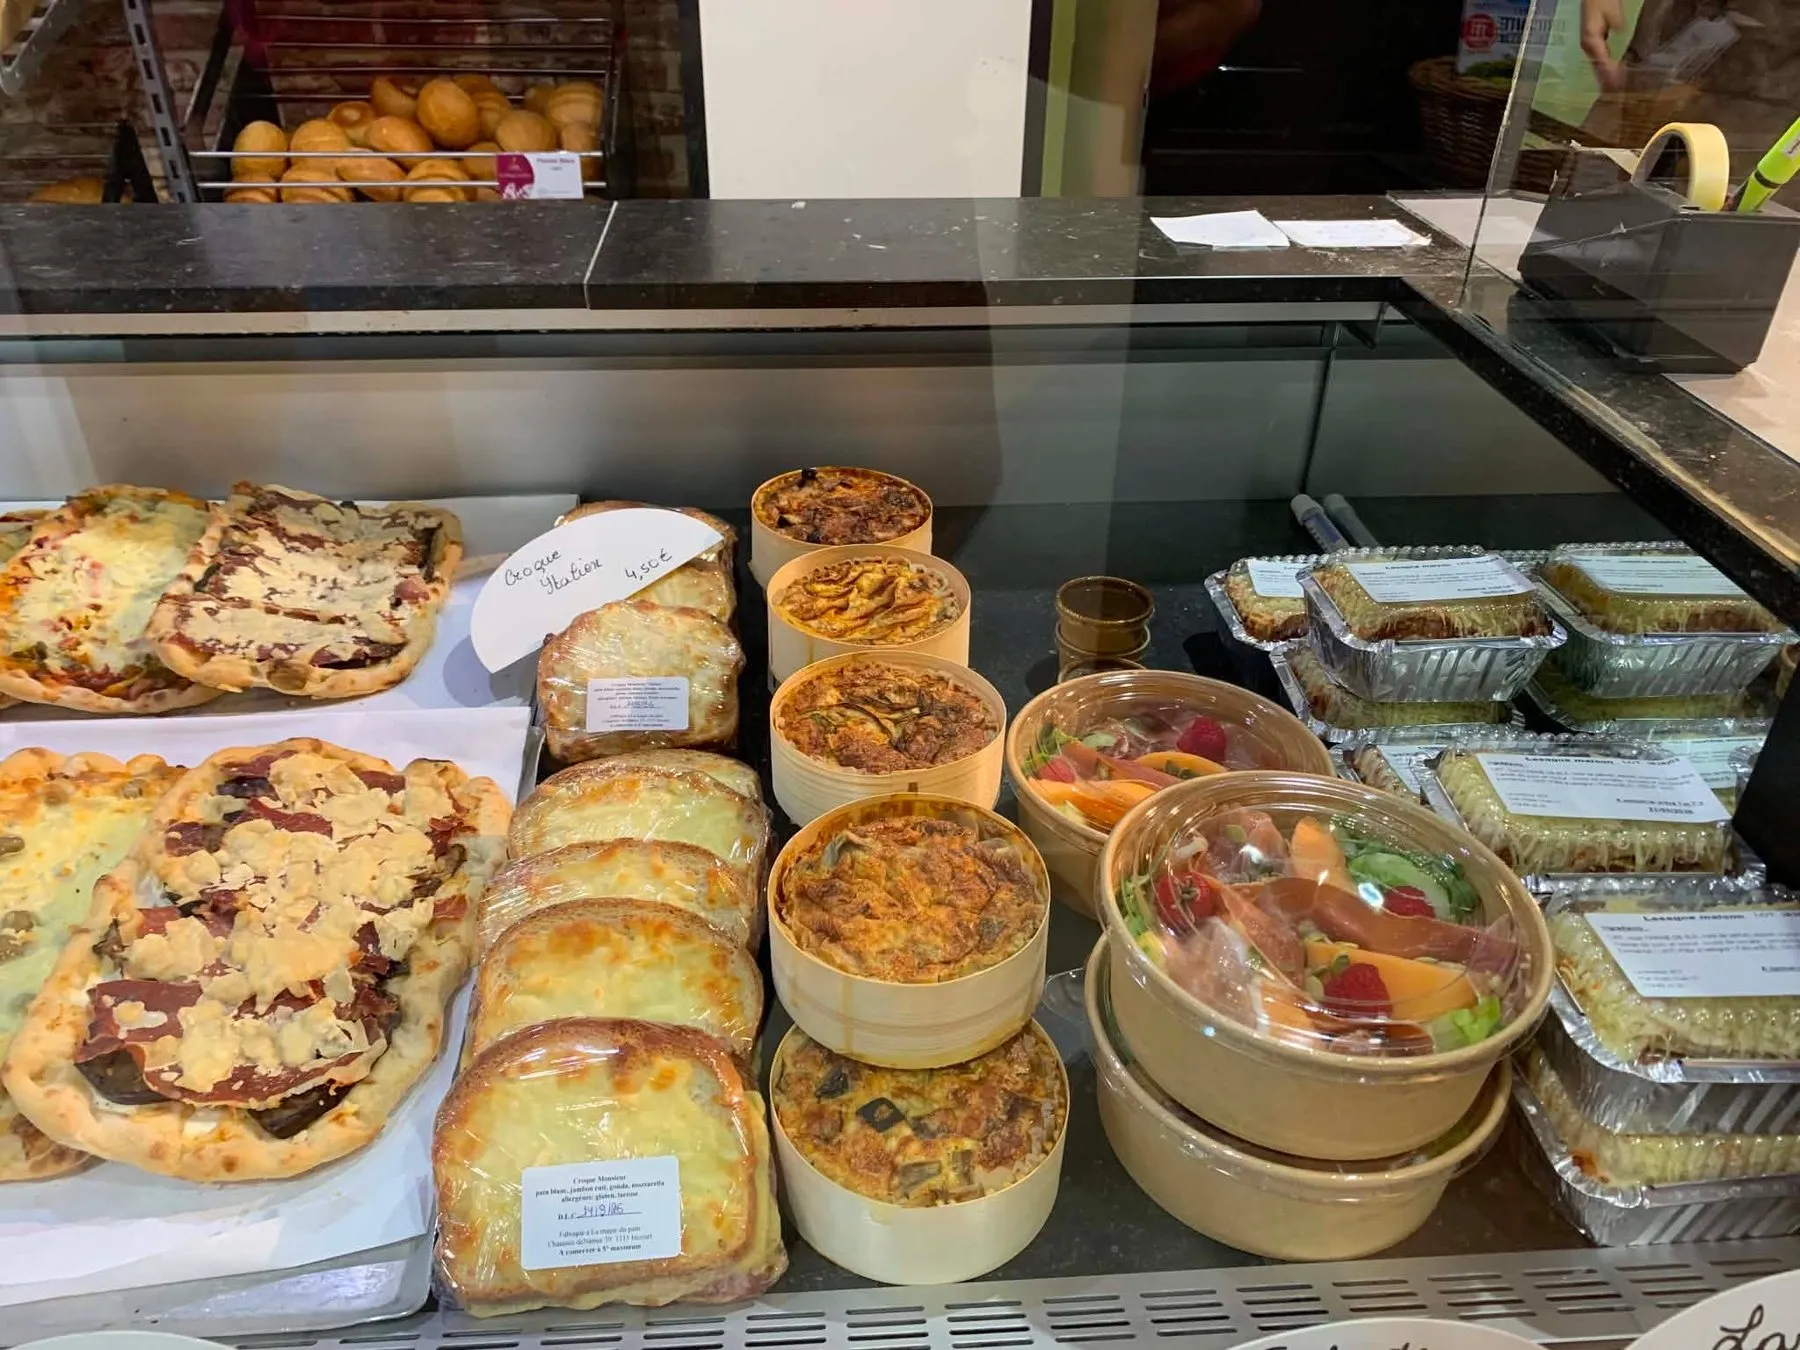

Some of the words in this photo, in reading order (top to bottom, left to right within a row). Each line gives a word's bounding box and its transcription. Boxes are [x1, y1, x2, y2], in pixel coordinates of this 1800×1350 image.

[504, 550, 561, 586] Croque
[625, 547, 673, 581] 4,50€
[536, 1189, 550, 1198] pain
[569, 1186, 593, 1195] jambon
[631, 1180, 665, 1189] mozzarella
[573, 1176, 596, 1185] Croque
[598, 1174, 626, 1183] Monsieur
[1712, 1302, 1800, 1350] La
